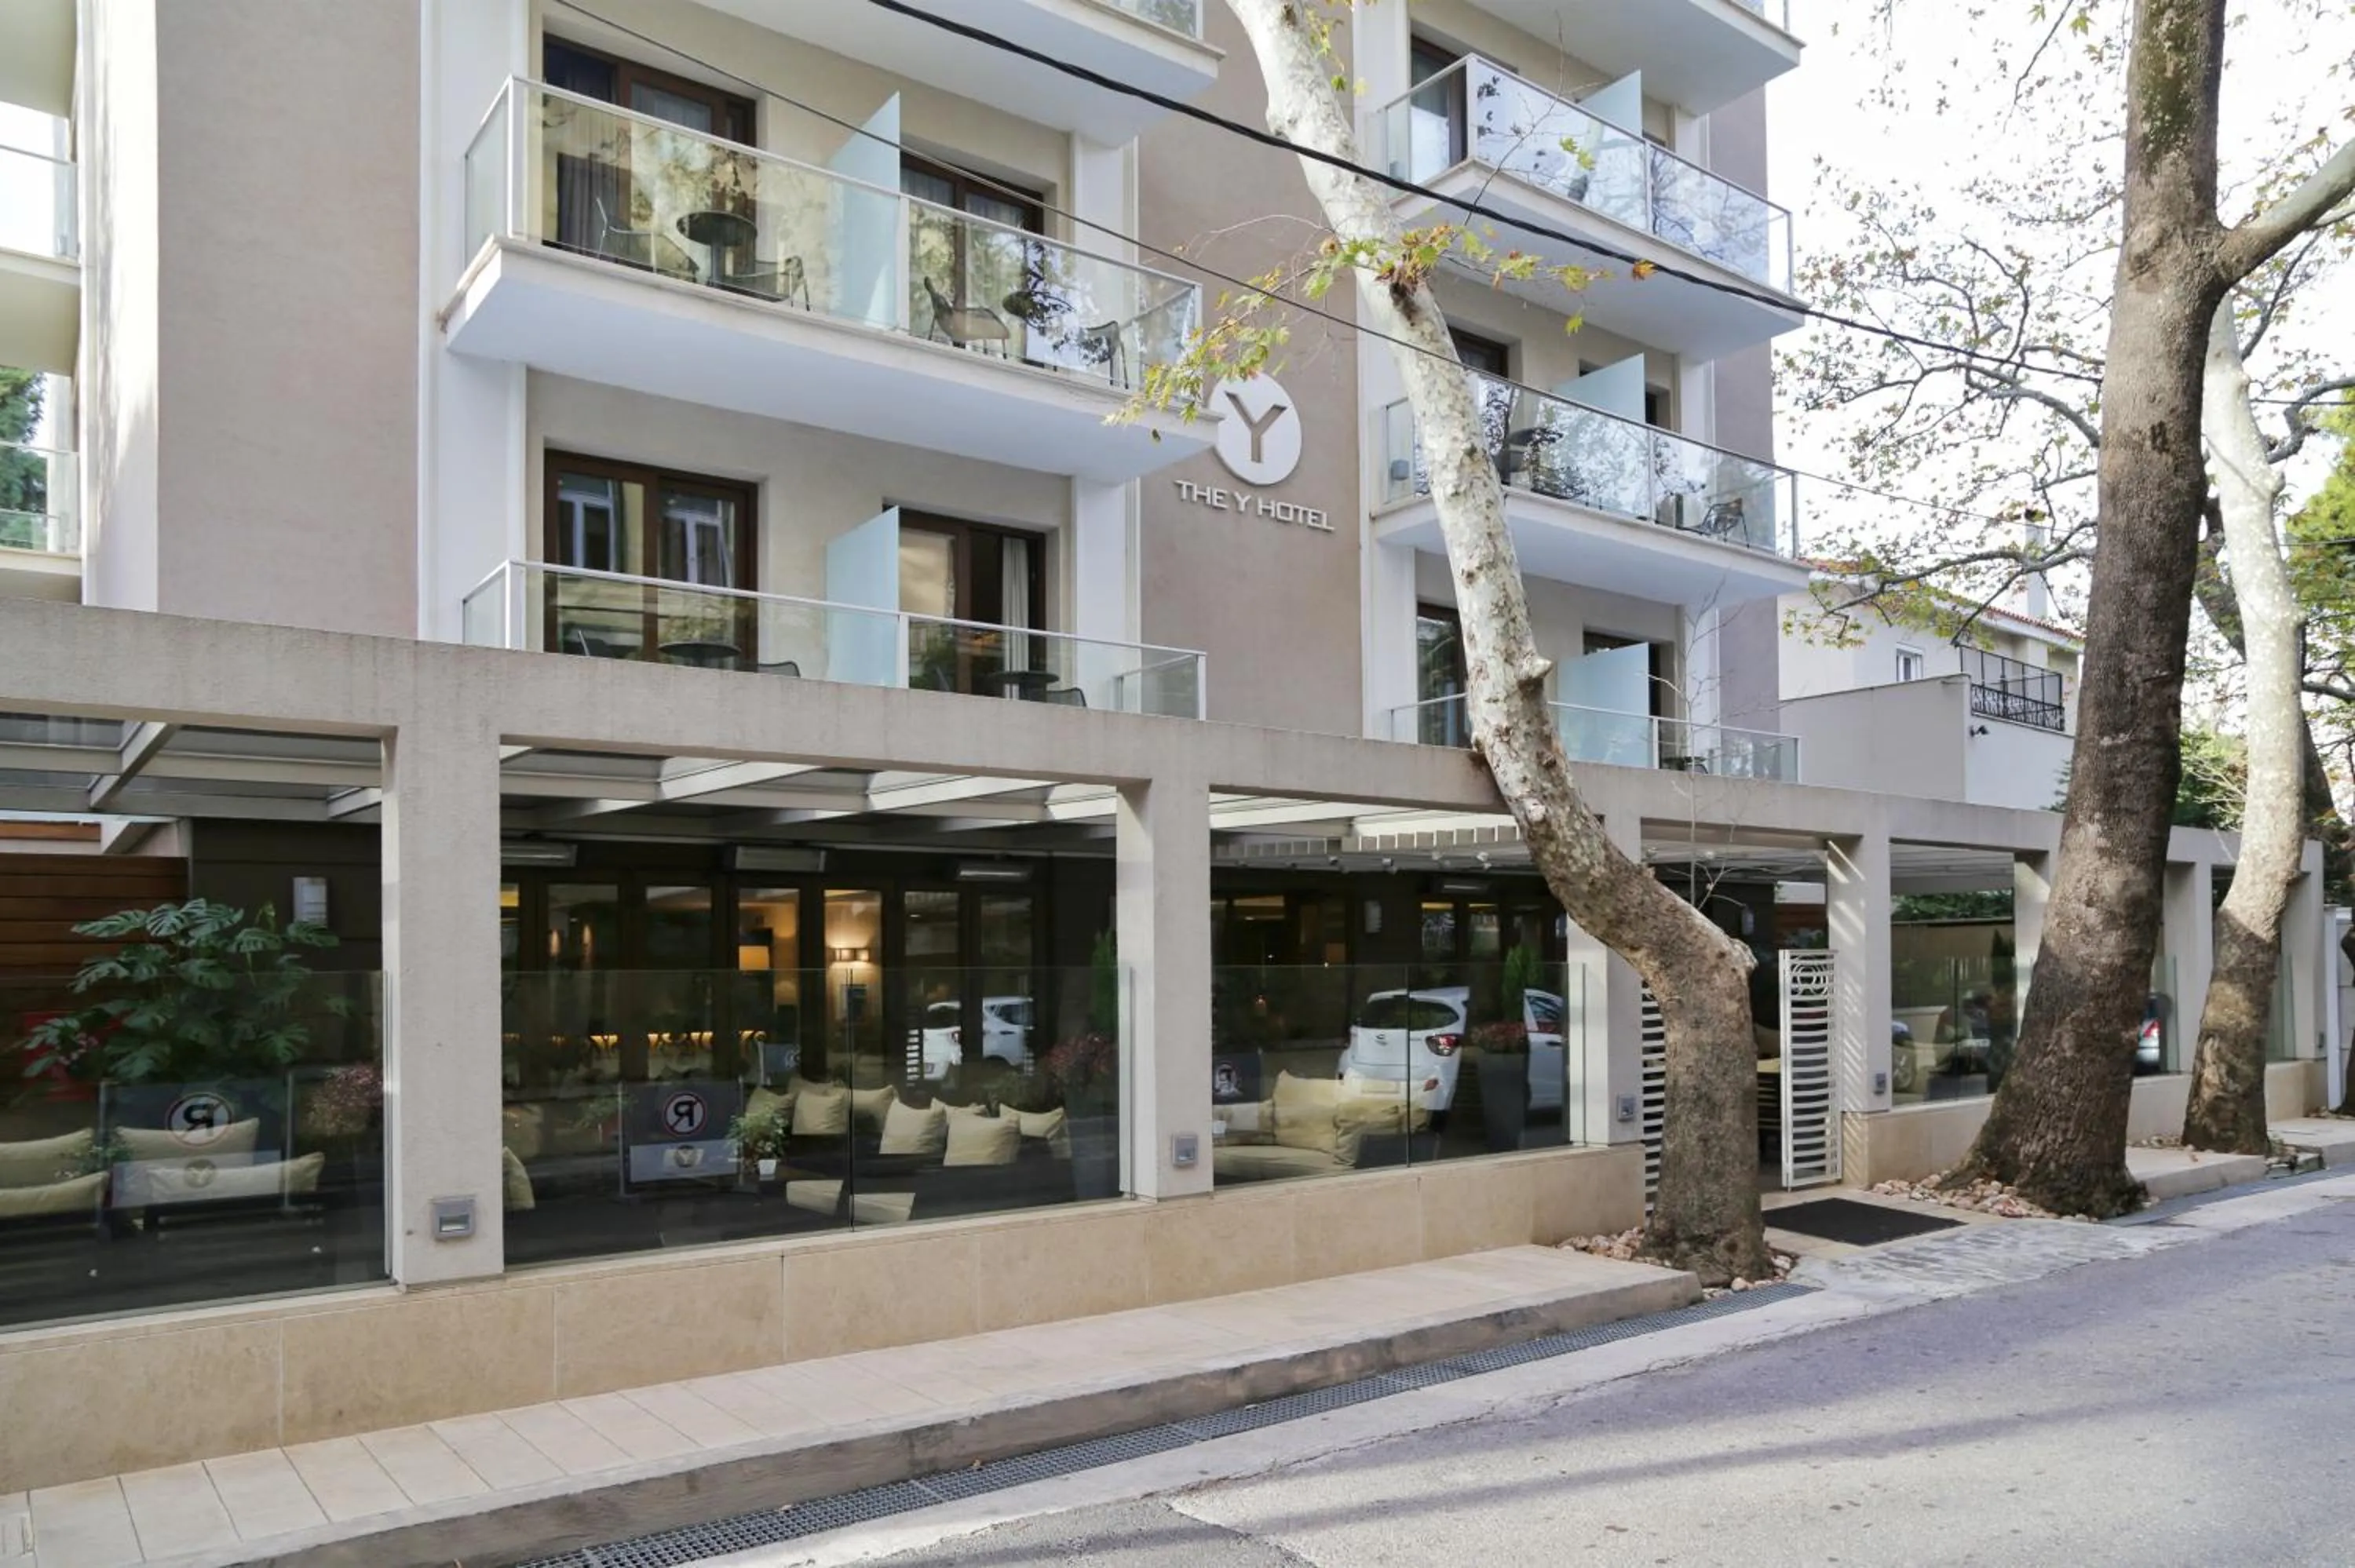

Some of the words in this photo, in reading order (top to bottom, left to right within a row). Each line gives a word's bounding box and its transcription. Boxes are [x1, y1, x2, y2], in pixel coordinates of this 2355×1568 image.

[1225, 391, 1287, 463] Y
[1174, 480, 1229, 510] THE
[1233, 490, 1251, 512] Y
[1257, 497, 1334, 532] HOTEL
